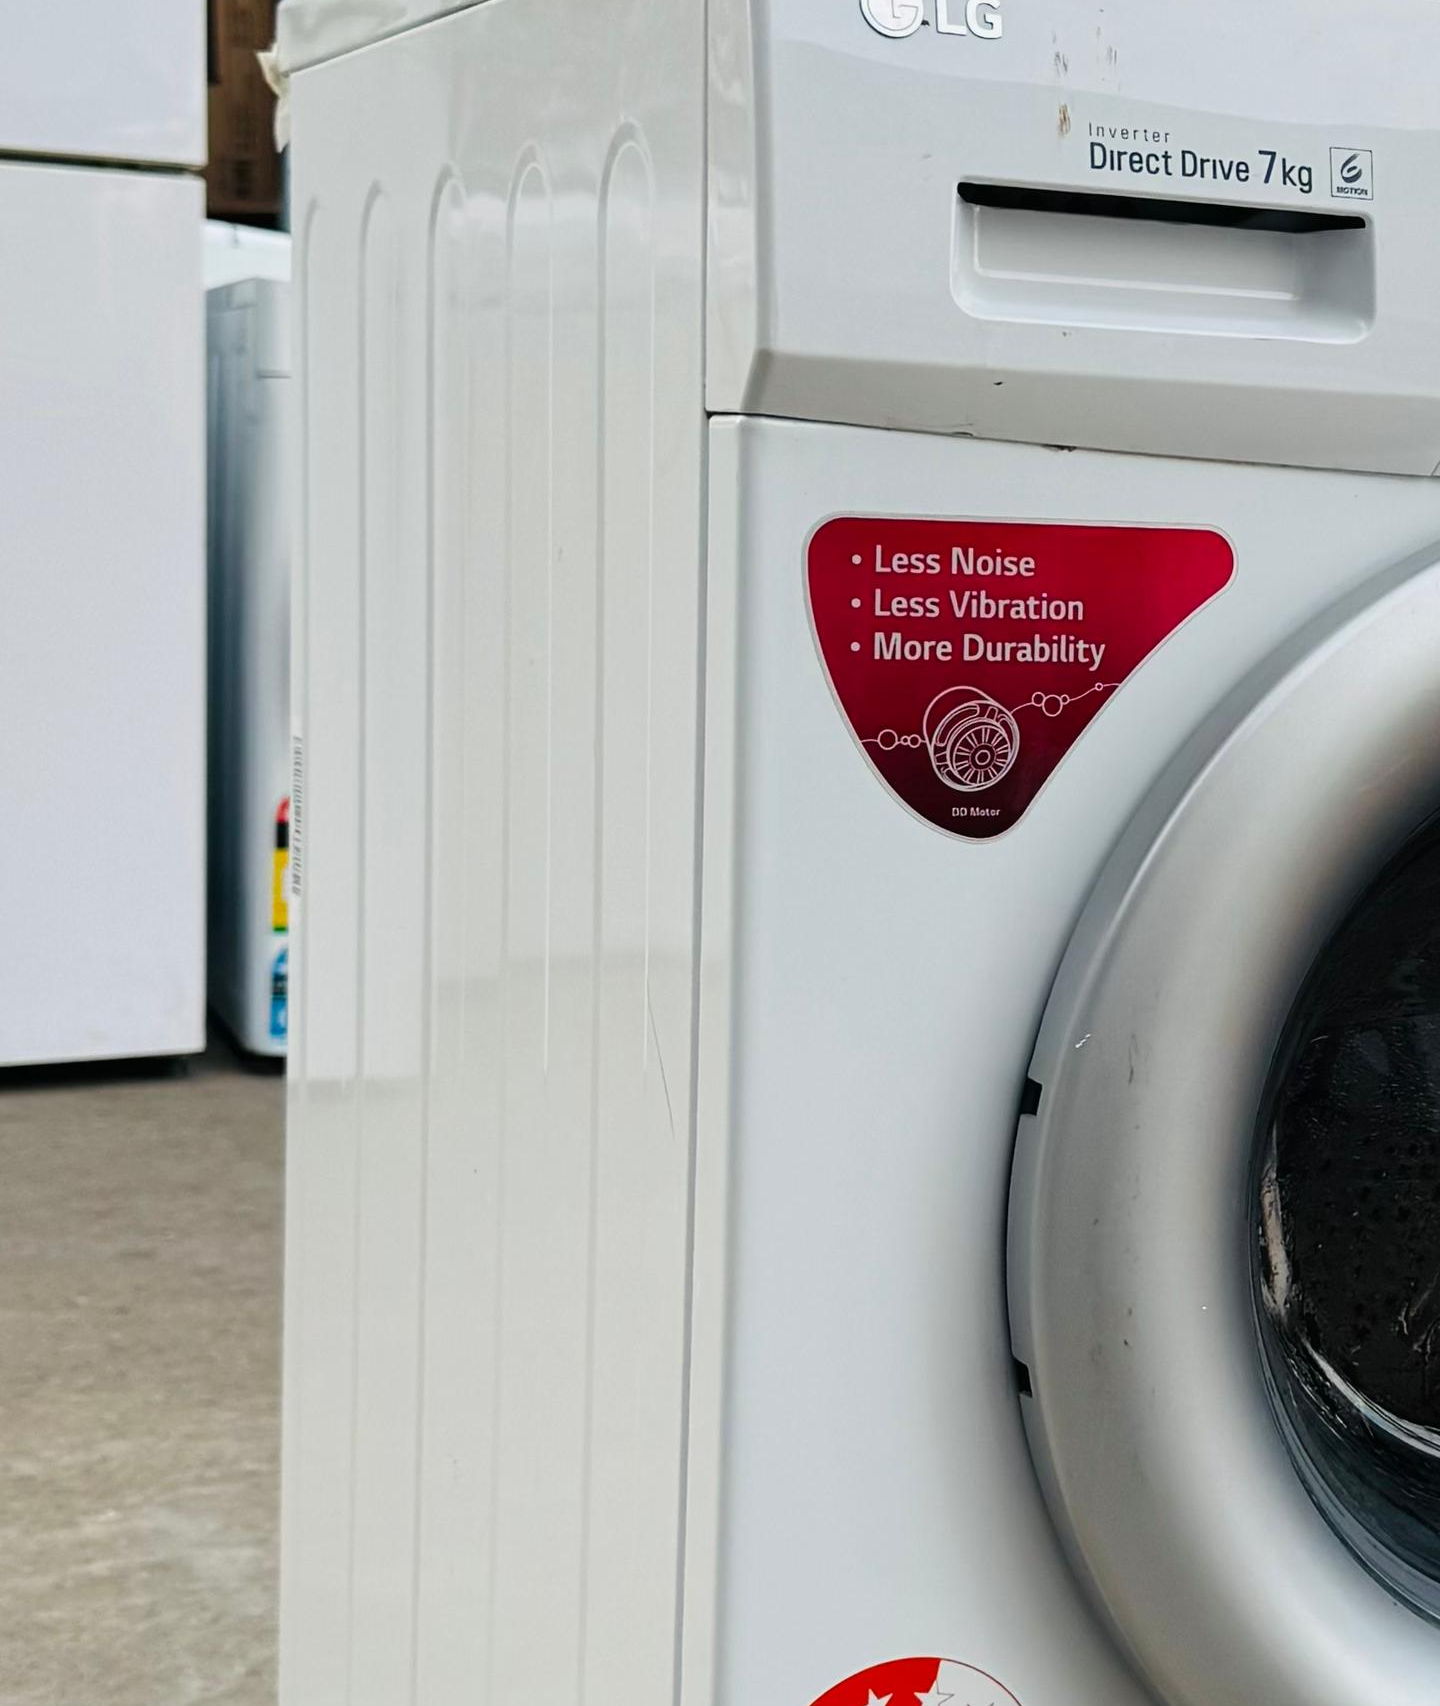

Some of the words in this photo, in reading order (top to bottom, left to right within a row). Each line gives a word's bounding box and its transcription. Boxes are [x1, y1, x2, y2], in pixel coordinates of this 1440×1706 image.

[1088, 122, 1170, 143] Inverter
[1089, 141, 1173, 177] Direct
[1181, 149, 1250, 182] Drive
[874, 545, 941, 574] Less
[951, 547, 1036, 577] Noise
[874, 589, 940, 618] Less
[949, 591, 1084, 621] Vibration
[873, 632, 952, 661] More
[963, 633, 1106, 671] Durability
[970, 807, 1000, 817] Motor
